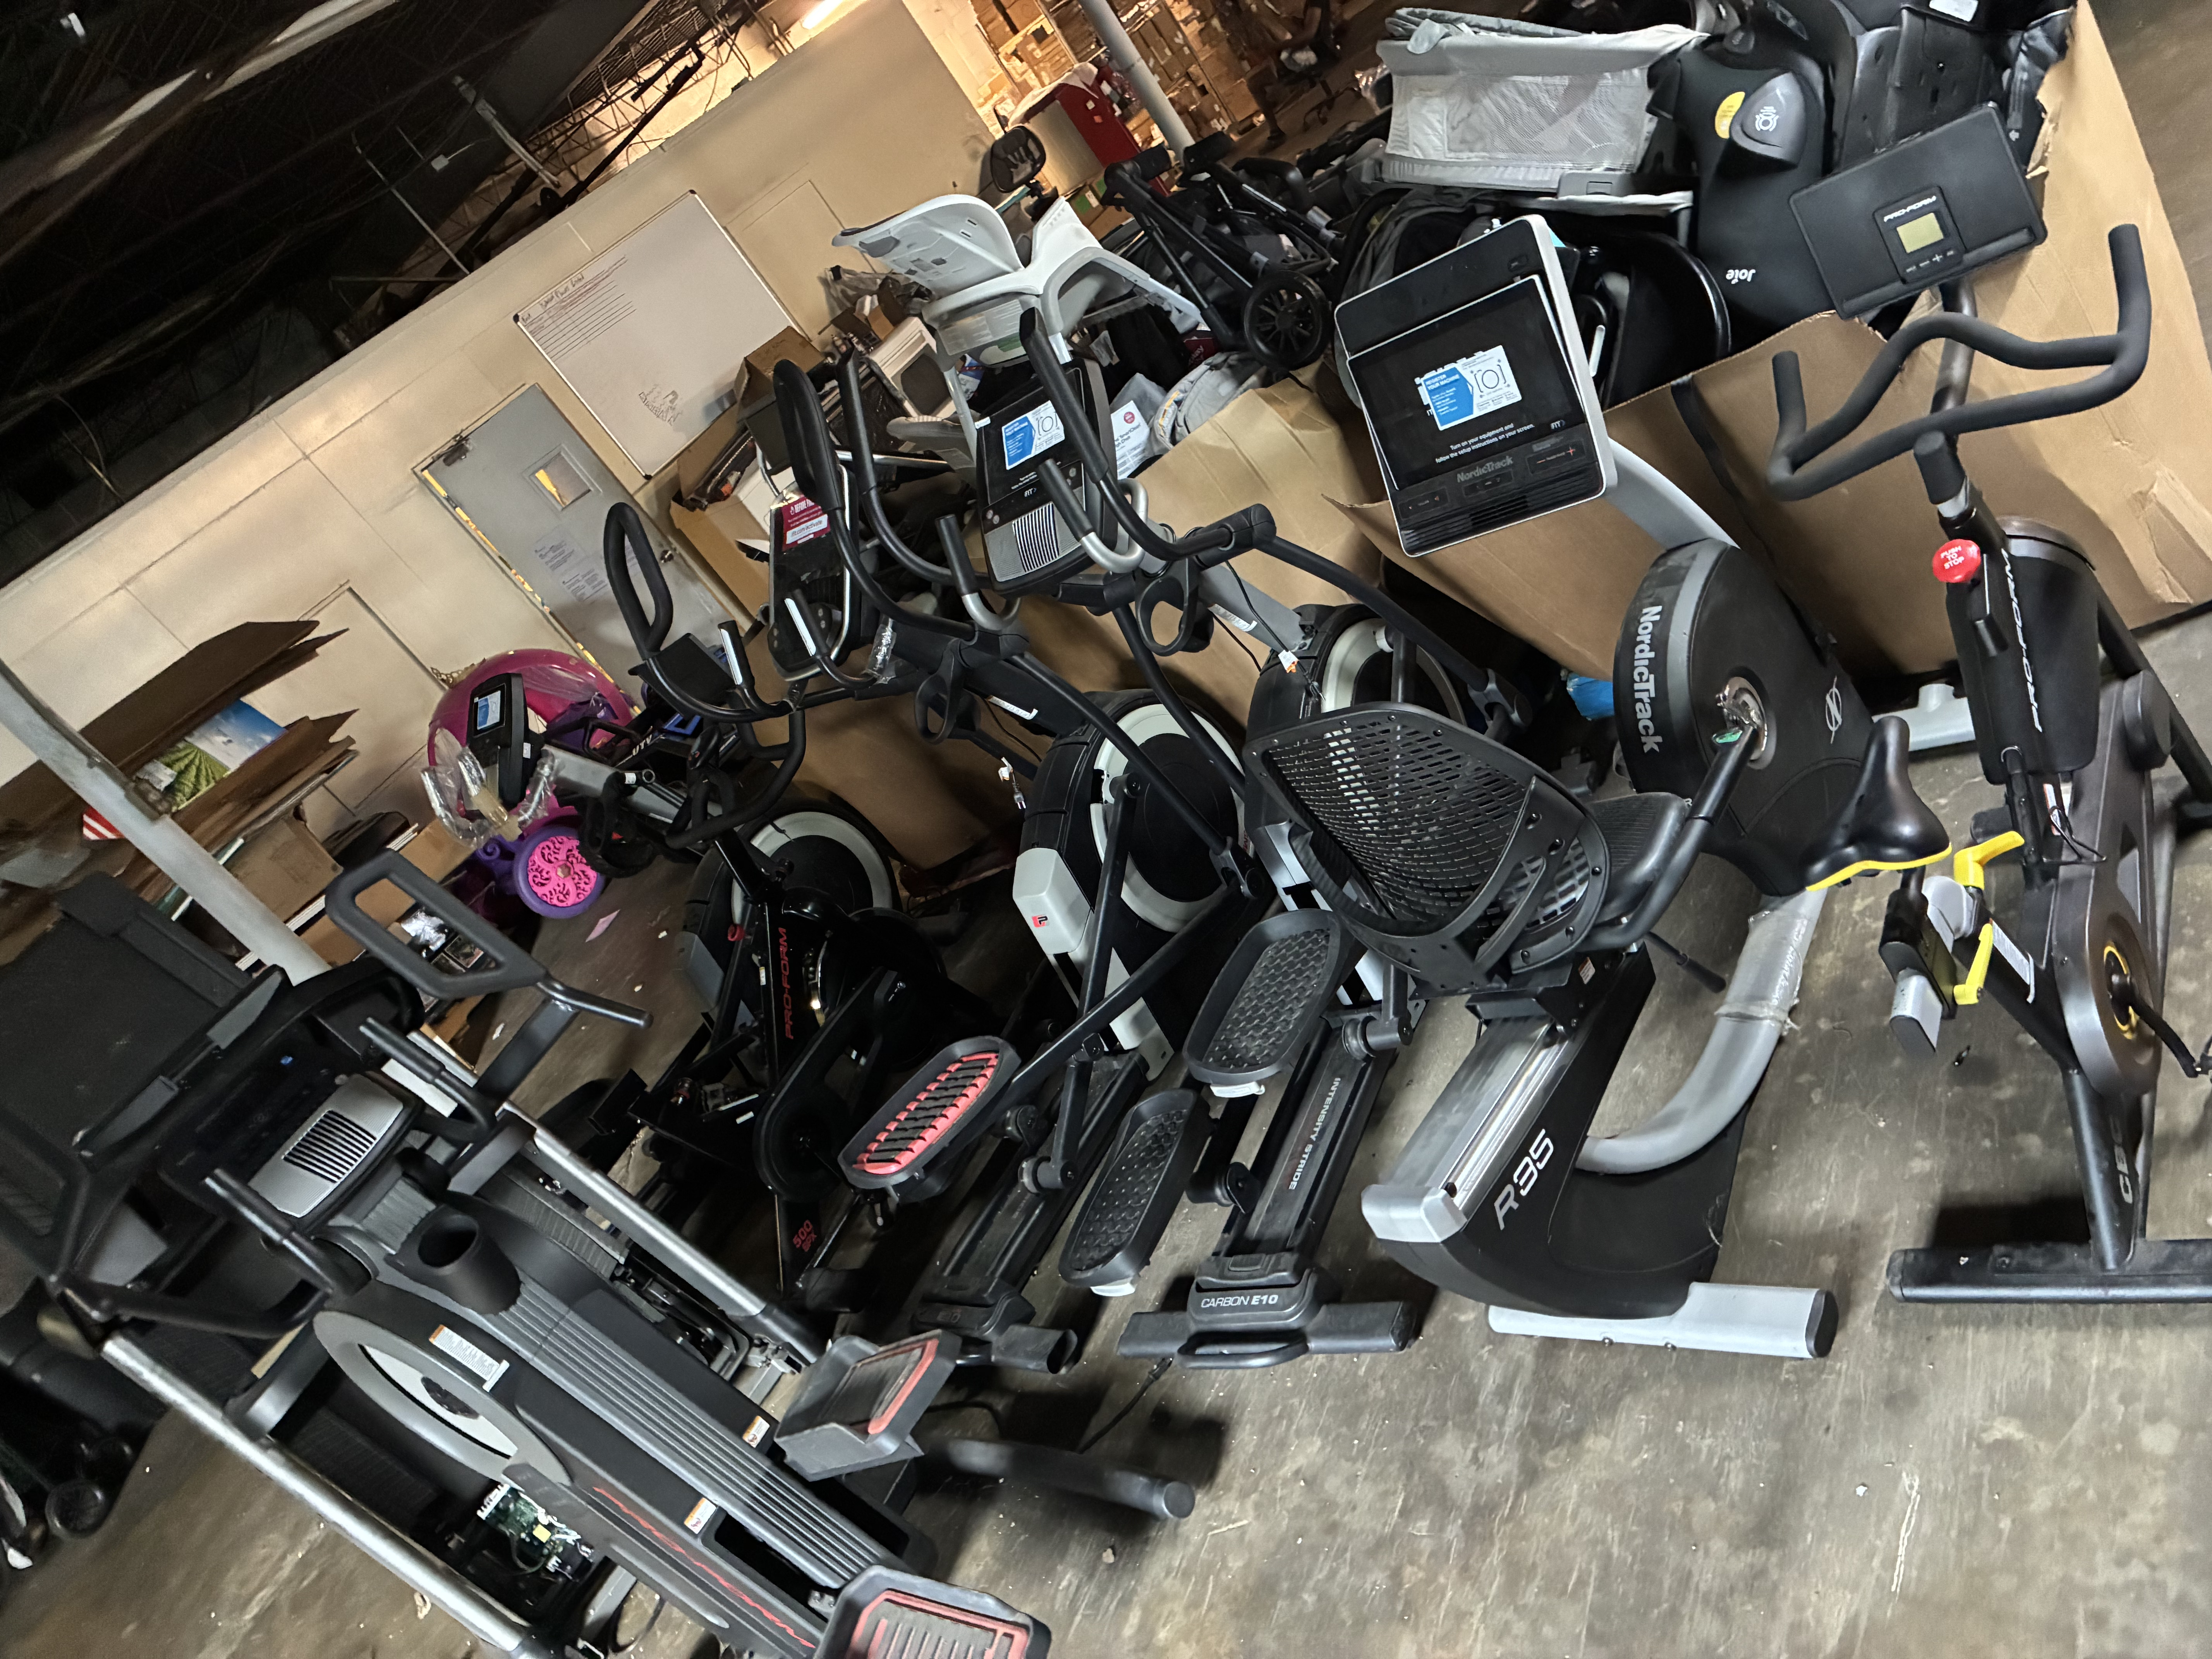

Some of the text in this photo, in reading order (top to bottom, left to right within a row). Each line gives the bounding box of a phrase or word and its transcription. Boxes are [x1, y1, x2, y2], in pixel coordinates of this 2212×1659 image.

[1726, 269, 1756, 284] Joie
[1458, 447, 1472, 455] setup
[1471, 436, 1499, 450] instructions
[1505, 430, 1516, 438] your
[1467, 436, 1479, 445] your
[1479, 427, 1504, 440] equipment
[1457, 455, 1513, 483] NordicTrack
[1940, 545, 1962, 559] PUSH
[1944, 556, 1965, 570] STOP
[1946, 553, 1958, 561] TO
[2001, 548, 2042, 733] PRO-FORM
[1633, 605, 1662, 754] NordicTrack
[778, 927, 793, 1040] PRO-FORM
[1310, 1077, 1341, 1142] INTENSITY
[1288, 1144, 1313, 1190] STRIDE
[1494, 1128, 1554, 1231] R35
[793, 1219, 813, 1248] 500
[1201, 1295, 1279, 1308] CARBON E10
